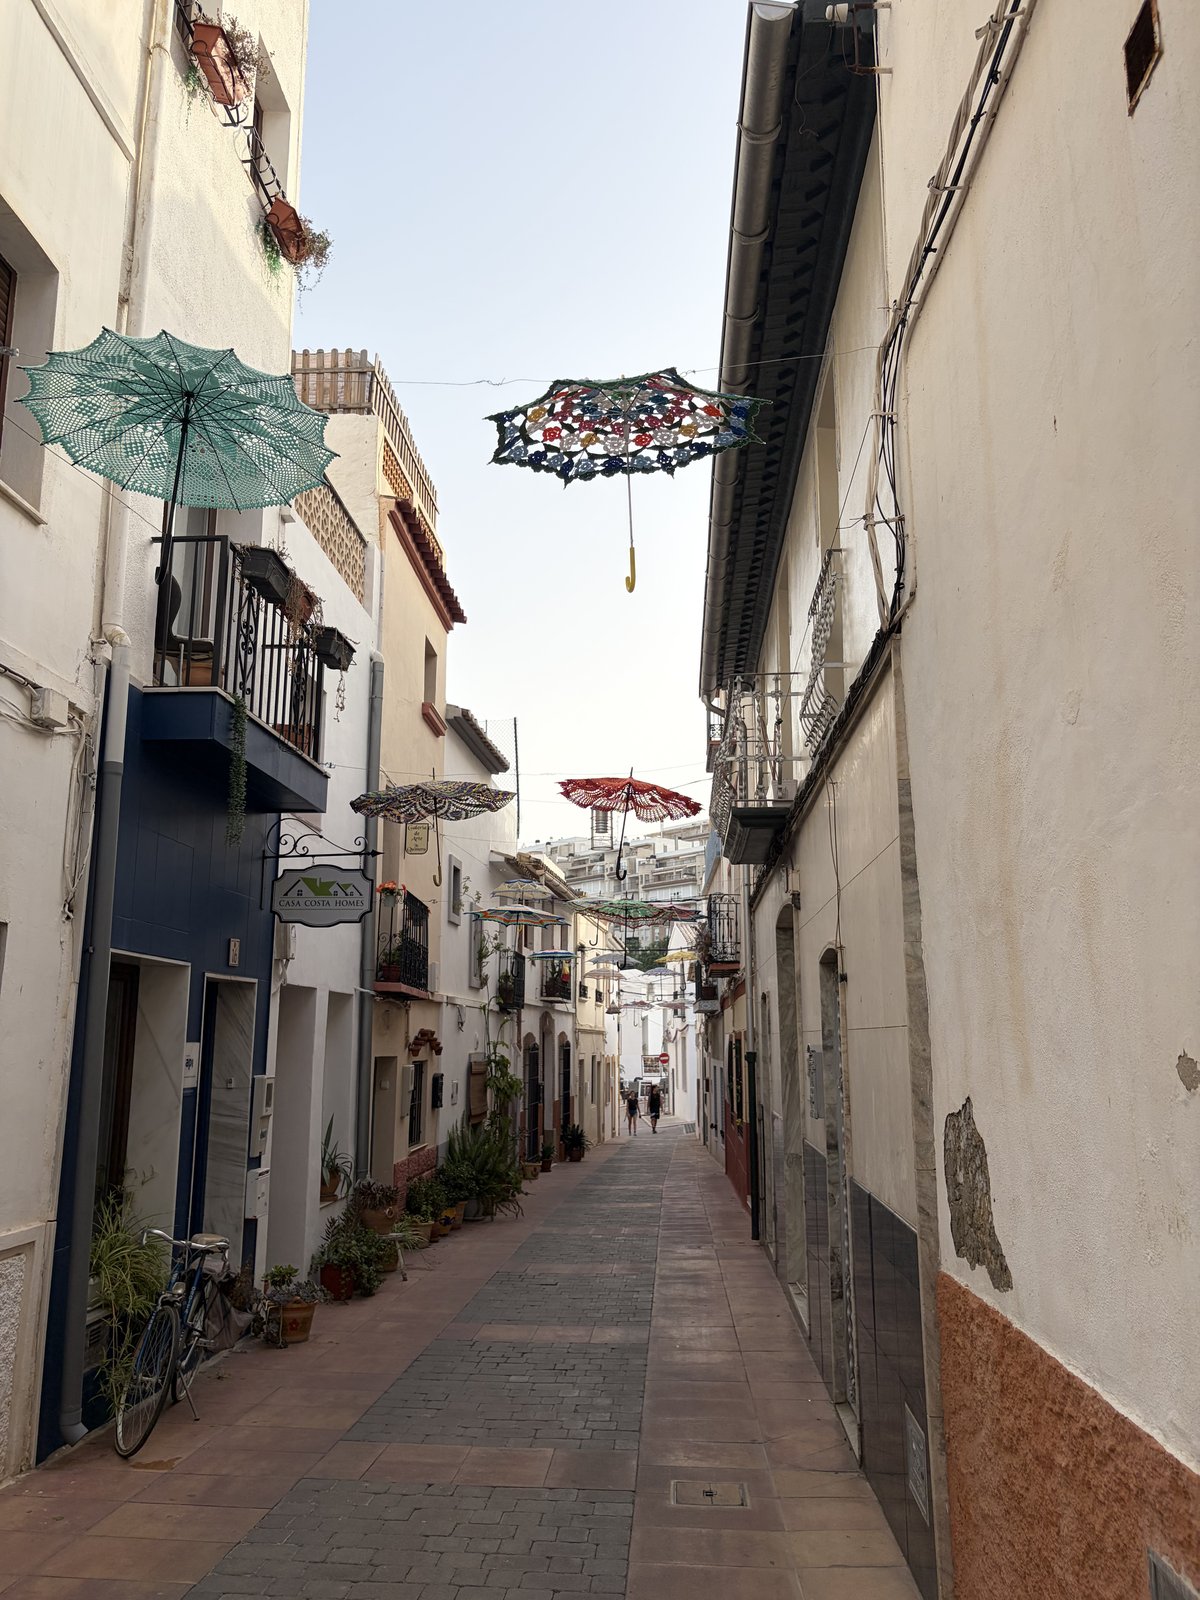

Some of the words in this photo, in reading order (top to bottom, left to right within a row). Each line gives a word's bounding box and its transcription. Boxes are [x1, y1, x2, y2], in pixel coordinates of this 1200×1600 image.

[278, 899, 301, 907] CASA
[304, 899, 331, 907] COSTA
[335, 899, 364, 907] HOMES
